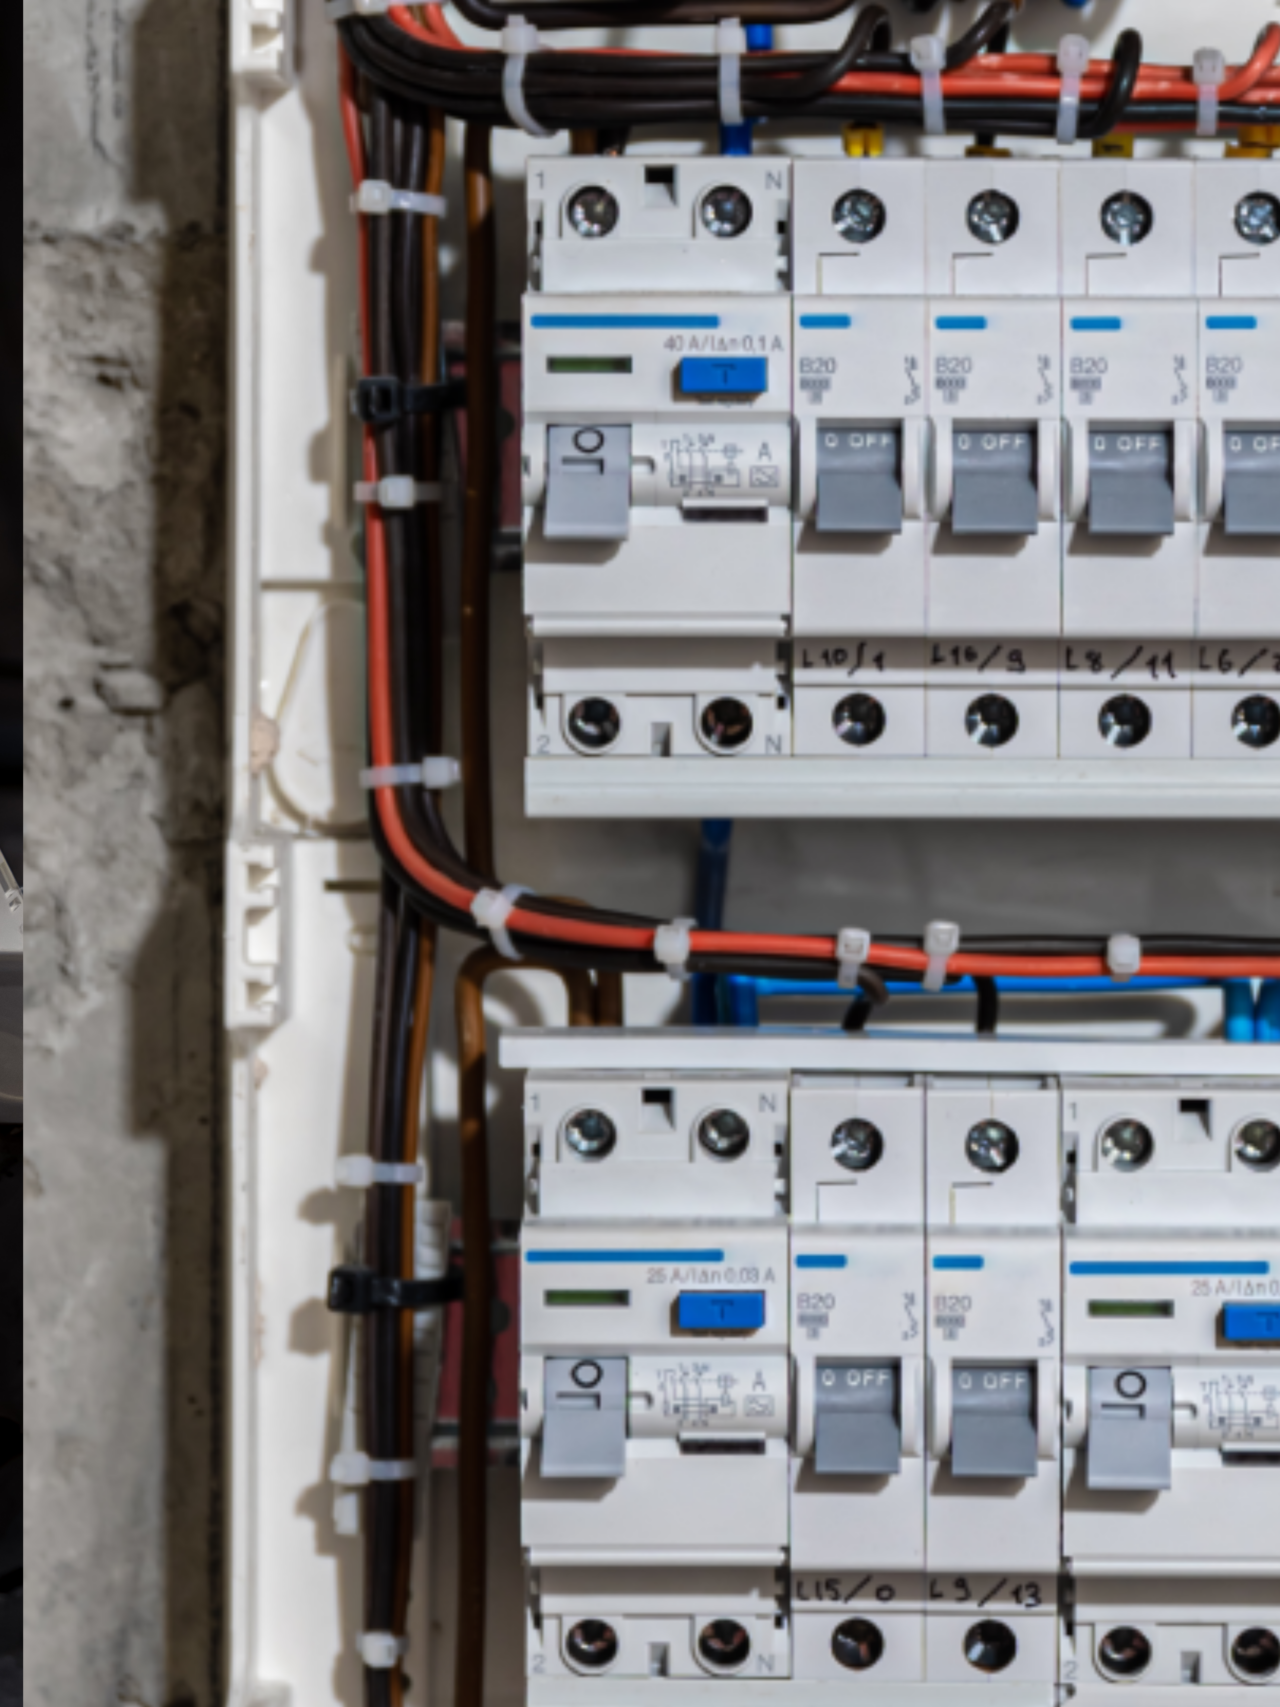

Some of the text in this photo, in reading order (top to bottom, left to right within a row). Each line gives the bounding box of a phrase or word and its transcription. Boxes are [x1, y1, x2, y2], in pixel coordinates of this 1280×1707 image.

[765, 171, 781, 188] N
[663, 334, 683, 352] 40
[770, 334, 784, 352] A
[800, 357, 837, 374] B20
[935, 357, 972, 374] B20
[1070, 357, 1107, 374] B20
[1205, 357, 1242, 374] B20
[850, 433, 892, 448] OFF
[985, 434, 1026, 450] OFF
[1118, 436, 1161, 452] OFF
[536, 736, 551, 754] 2
[765, 736, 781, 753] N
[759, 1095, 776, 1112] N
[762, 1266, 776, 1284] A
[847, 1371, 890, 1386] OFF
[984, 1373, 1026, 1388] OFF
[757, 1655, 774, 1673] N
